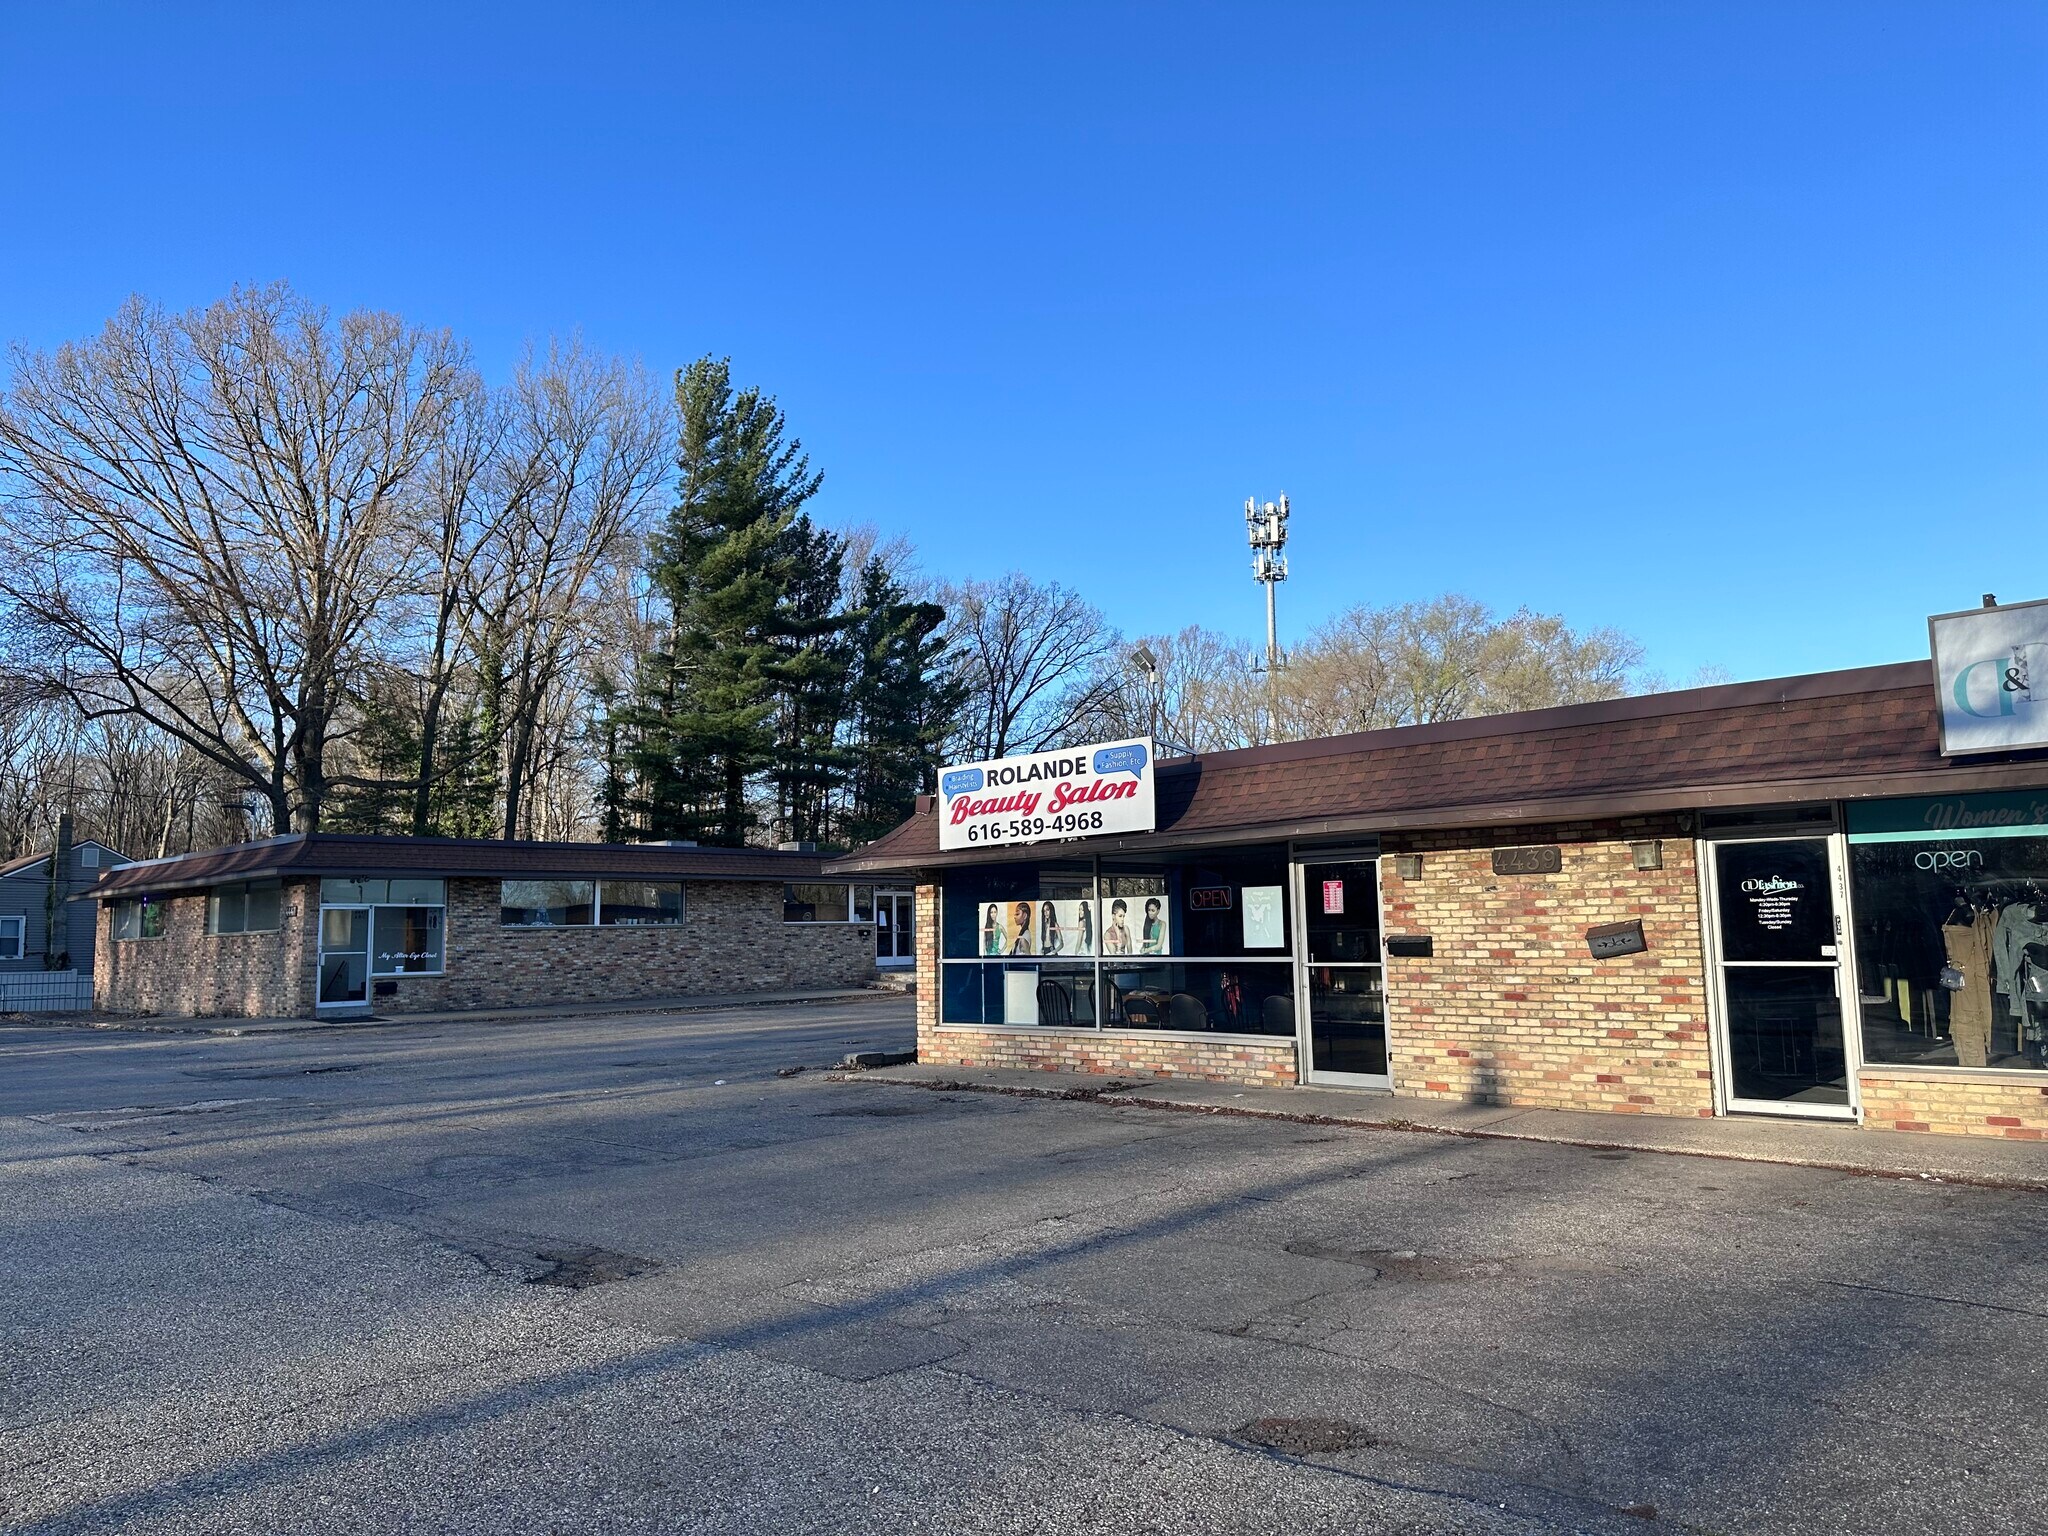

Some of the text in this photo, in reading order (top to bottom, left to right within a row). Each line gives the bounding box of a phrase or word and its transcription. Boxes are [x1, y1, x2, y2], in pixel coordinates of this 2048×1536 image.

[1110, 750, 1132, 759] Supply
[1130, 757, 1141, 765] Etc
[987, 756, 1087, 787] ROLANDE
[950, 779, 1139, 825] Beauty Salon
[1923, 799, 2048, 829] Women's
[968, 811, 1103, 841] 616-589-4968
[1495, 849, 1555, 871] 4439
[1914, 850, 1983, 873] open
[1192, 890, 1230, 907] OPEN
[378, 952, 390, 960] My
